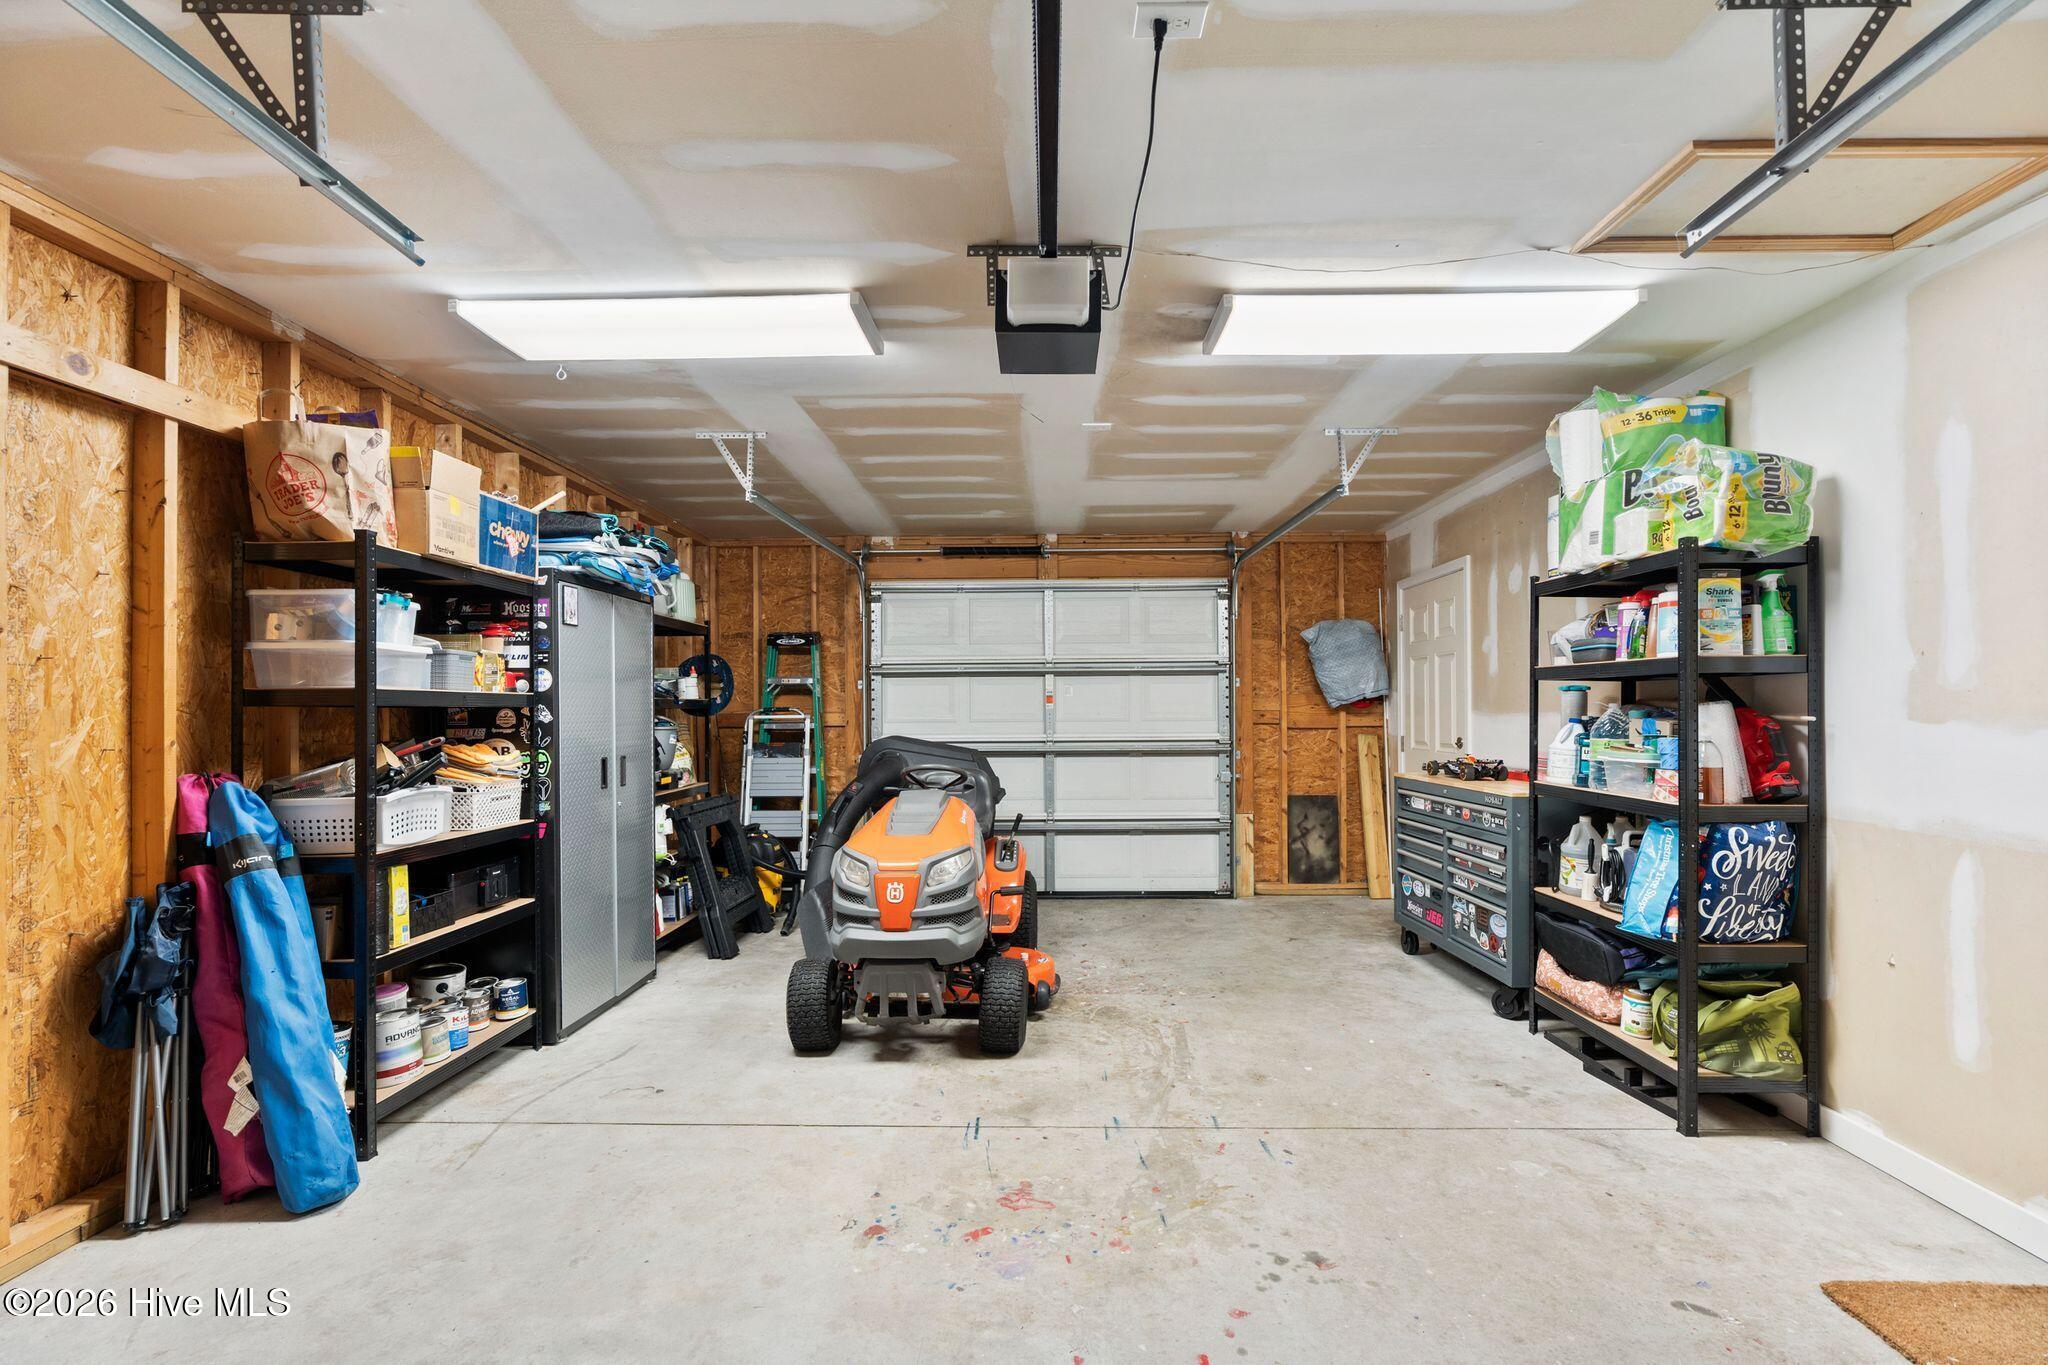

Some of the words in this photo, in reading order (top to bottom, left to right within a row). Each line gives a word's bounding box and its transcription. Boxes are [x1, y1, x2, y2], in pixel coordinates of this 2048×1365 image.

[1636, 411, 1653, 422] 36
[1653, 408, 1677, 417] Triple
[274, 479, 320, 501] TRADER
[283, 492, 315, 511] JOE'S
[1728, 505, 1742, 519] 12
[489, 521, 530, 548] chewy
[1706, 588, 1734, 596] Shark
[502, 601, 548, 616] Hooser
[1660, 827, 1675, 871] Christmas
[1711, 827, 1797, 881] Sweet
[1650, 870, 1666, 889] Tree
[1637, 887, 1657, 913] Shops
[1698, 896, 1785, 942] Liberty
[1747, 903, 1761, 917] OF
